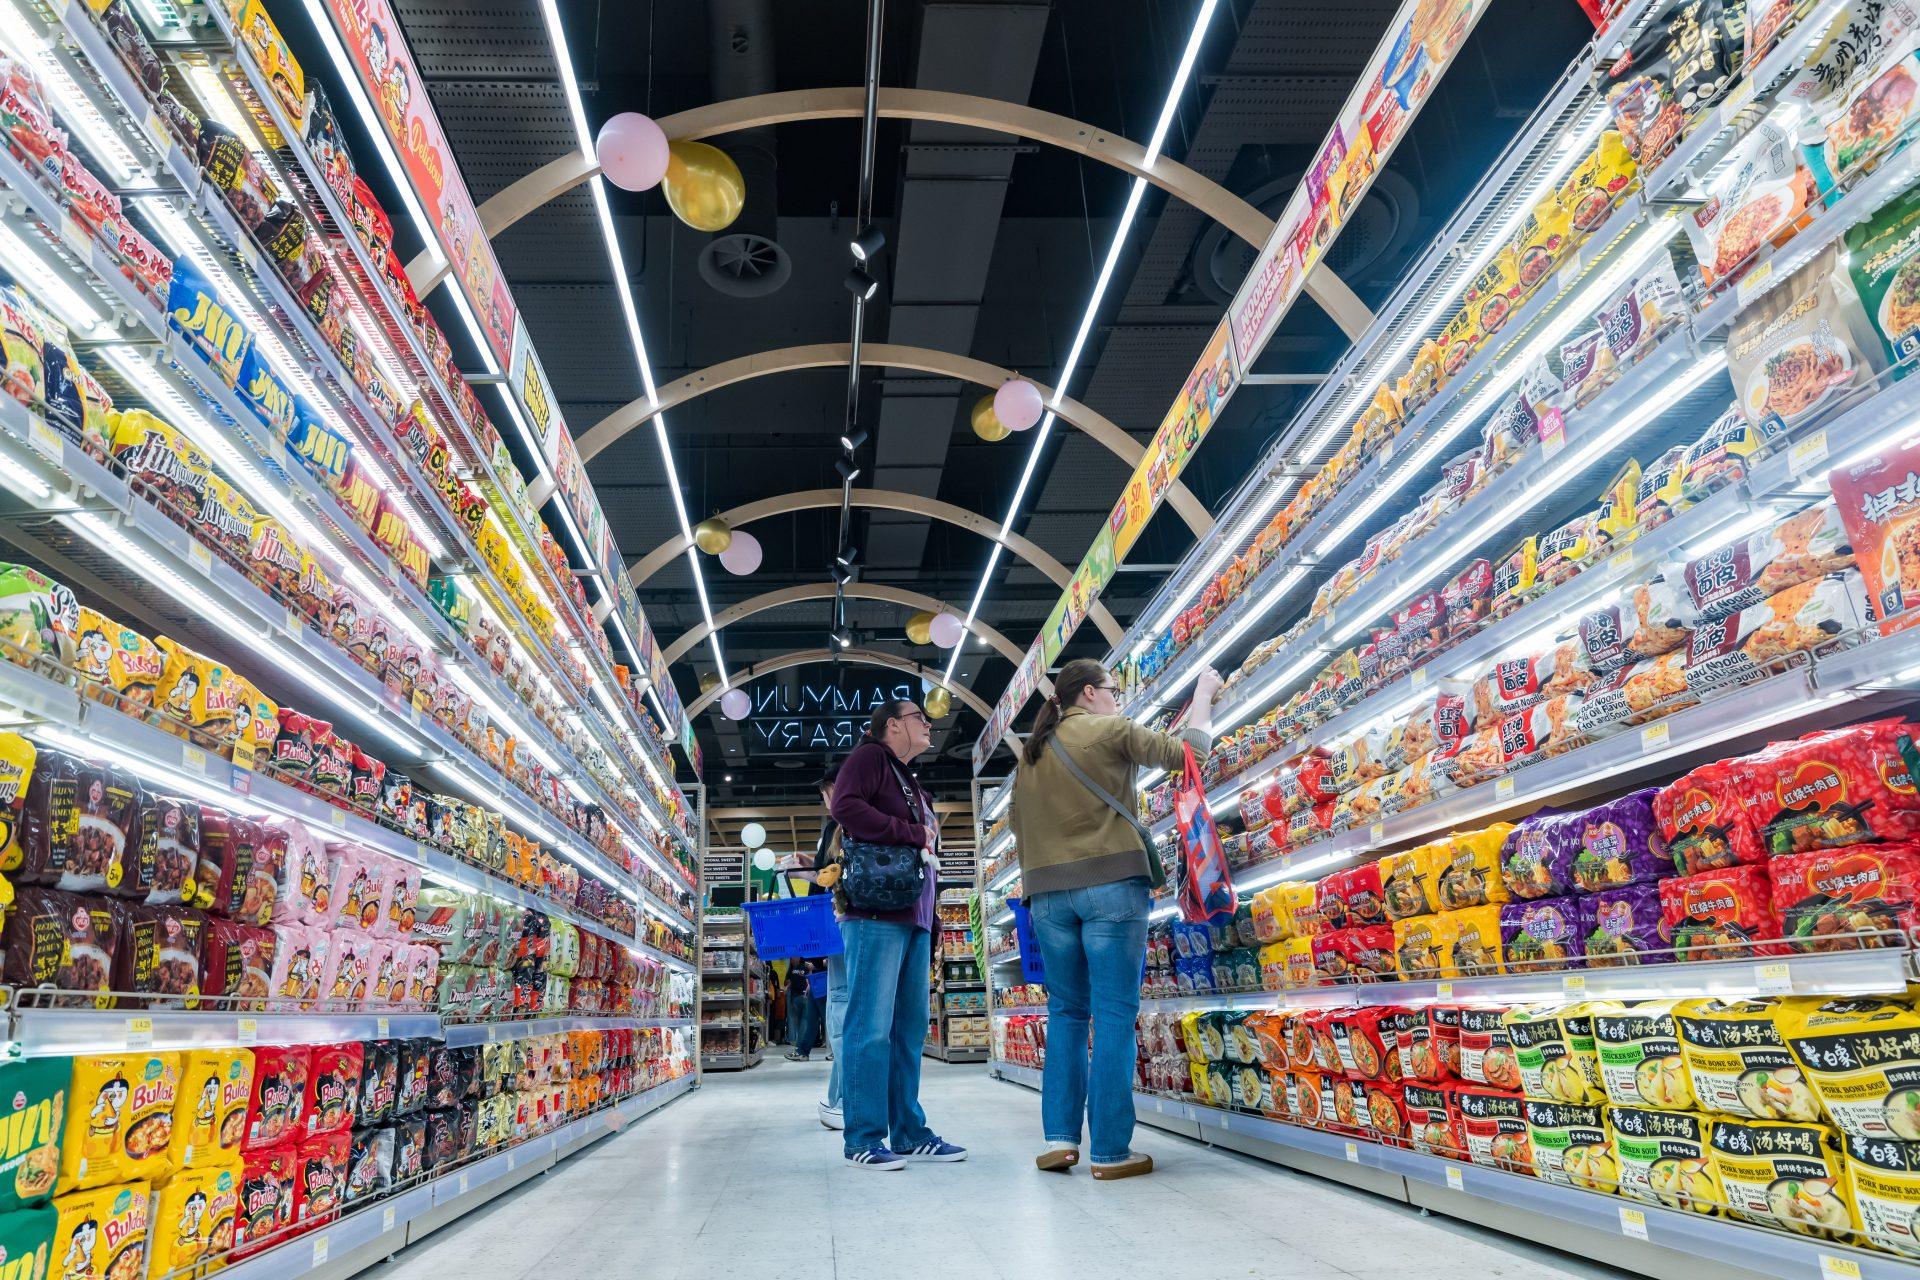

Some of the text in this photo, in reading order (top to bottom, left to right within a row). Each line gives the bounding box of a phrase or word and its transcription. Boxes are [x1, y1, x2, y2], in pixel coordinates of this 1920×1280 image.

[412, 123, 443, 190] Delicious
[1241, 259, 1275, 333] NOODLE
[1766, 423, 1777, 434] 8
[1697, 564, 1737, 597] 面皮
[1887, 595, 1896, 608] 8
[1706, 651, 1747, 672] Noodle
[1504, 672, 1528, 692] 面皮
[1520, 692, 1546, 709] Noodle
[1601, 700, 1628, 714] Flavor
[1609, 706, 1634, 722] Sour)
[1504, 732, 1527, 754] 面皮
[236, 746, 254, 763] TRENDING
[1760, 790, 1774, 801] 100
[1784, 773, 1840, 806] 红烧牛肉面
[1677, 799, 1712, 827] 红烧牛肉面
[1815, 870, 1880, 893] 红烧牛肉面
[1689, 897, 1734, 915] 红烧牛肉面
[1630, 1017, 1675, 1037] 汤好喝
[1601, 1050, 1626, 1061] CHICKEN
[1690, 1057, 1707, 1066] PORK
[1708, 1059, 1726, 1067] BONE
[1823, 1043, 1858, 1068] 白象
[1821, 1081, 1886, 1094] PORK BONE SOUP
[1558, 1106, 1597, 1126] 汤好喝
[1623, 1114, 1693, 1138] 白象 汤好喝
[1641, 1147, 1658, 1155] SOUP
[1728, 1129, 1814, 1155] 白象 汤好喝
[1870, 1142, 1906, 1167] 白象
[1719, 1164, 1739, 1174] PORK
[1739, 1167, 1756, 1176] BONE
[1857, 1177, 1878, 1190] PORK
[1879, 1183, 1903, 1194] BONE
[1832, 1259, 1856, 1272] £5.10
